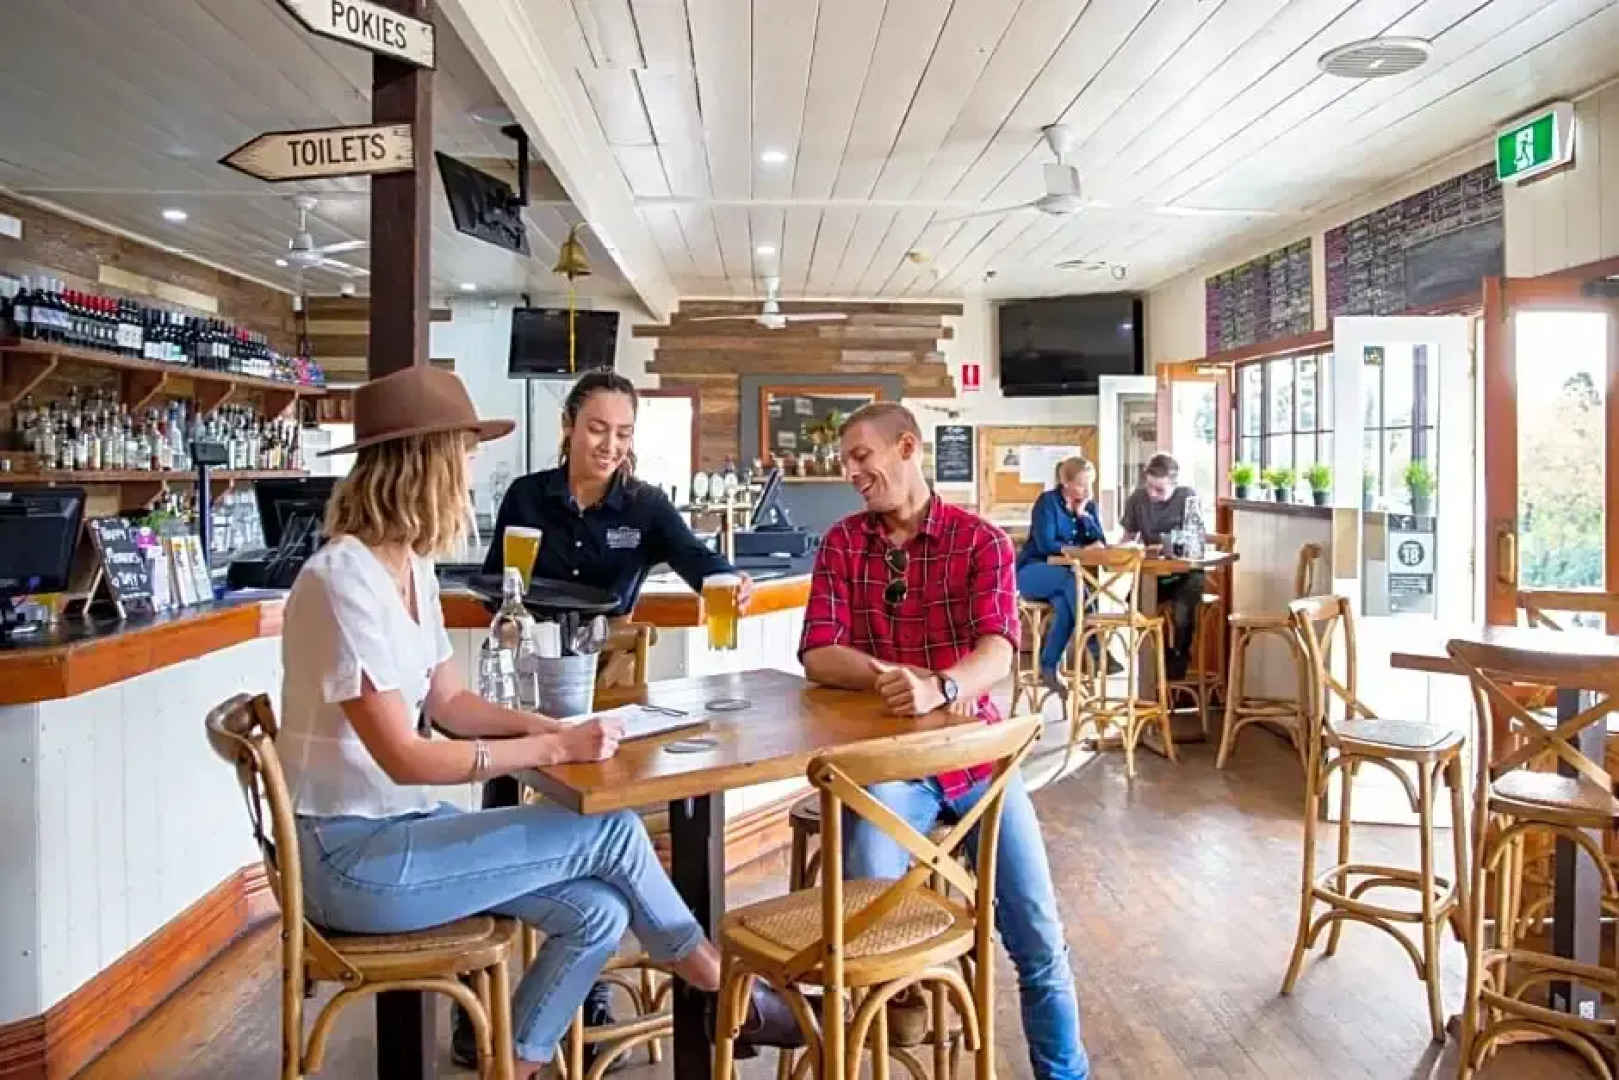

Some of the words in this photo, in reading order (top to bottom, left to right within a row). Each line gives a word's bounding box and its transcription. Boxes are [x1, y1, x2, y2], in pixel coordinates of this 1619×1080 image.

[332, 1, 407, 49] POKIES
[287, 133, 387, 167] TOILETS
[1402, 548, 1420, 564] 18
